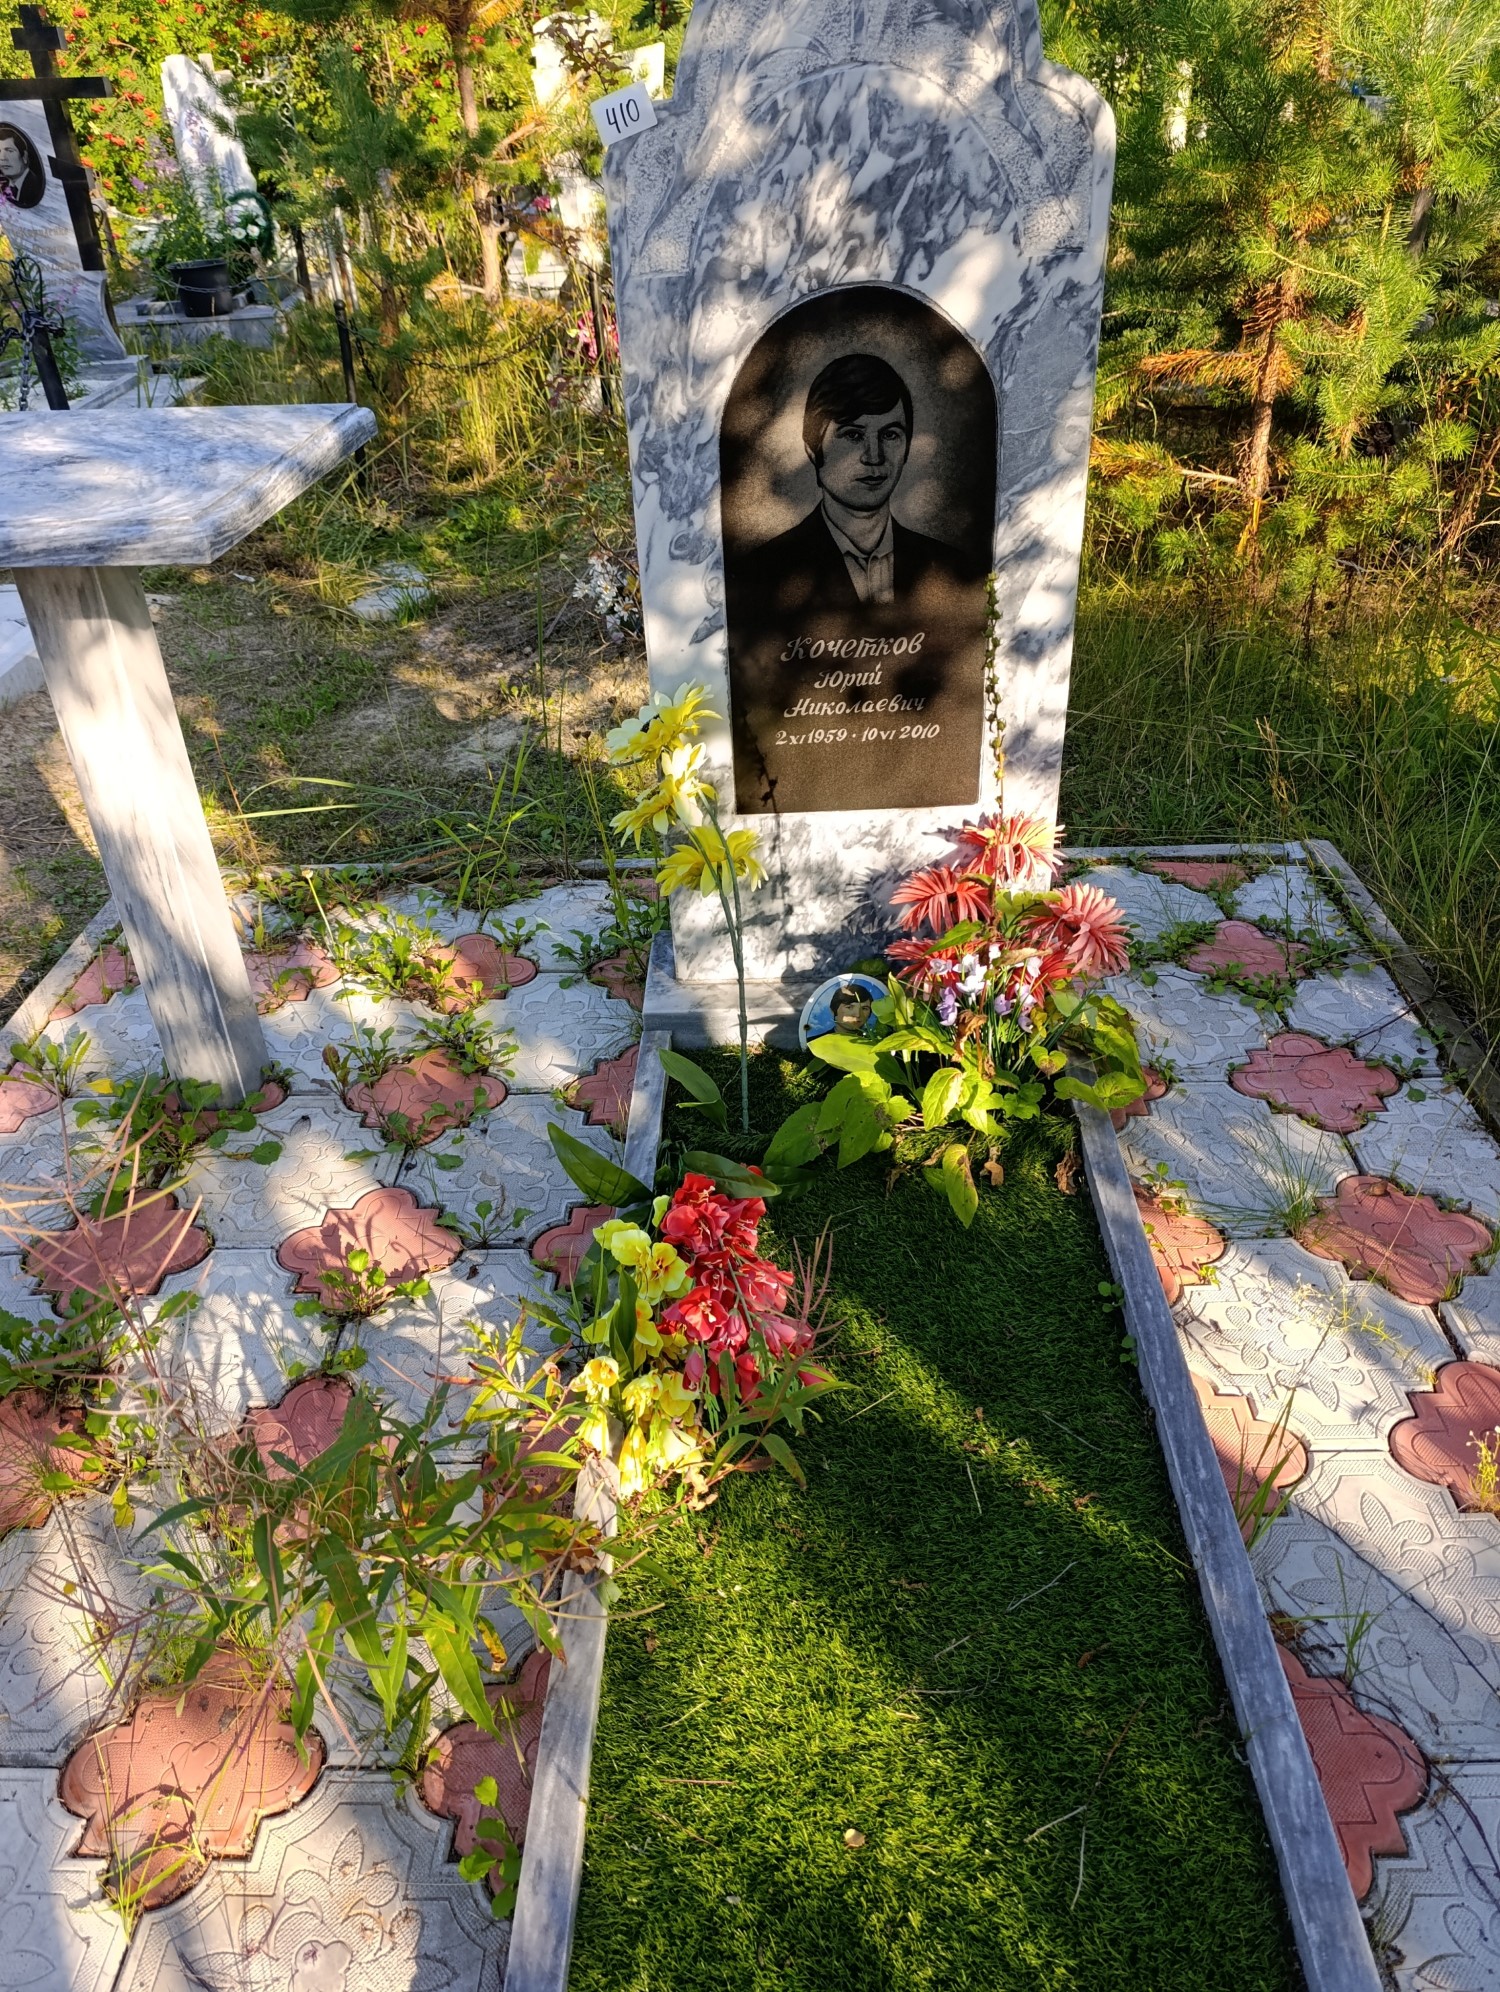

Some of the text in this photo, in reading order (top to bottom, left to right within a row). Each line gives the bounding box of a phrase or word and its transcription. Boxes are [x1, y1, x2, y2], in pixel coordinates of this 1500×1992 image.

[606, 99, 639, 133] 410
[780, 632, 925, 662] Кочетков
[814, 661, 882, 693] Юрий
[783, 694, 926, 718] Николаевич
[807, 728, 848, 743] 1959
[862, 726, 878, 742] 10
[899, 723, 940, 740] 2010
